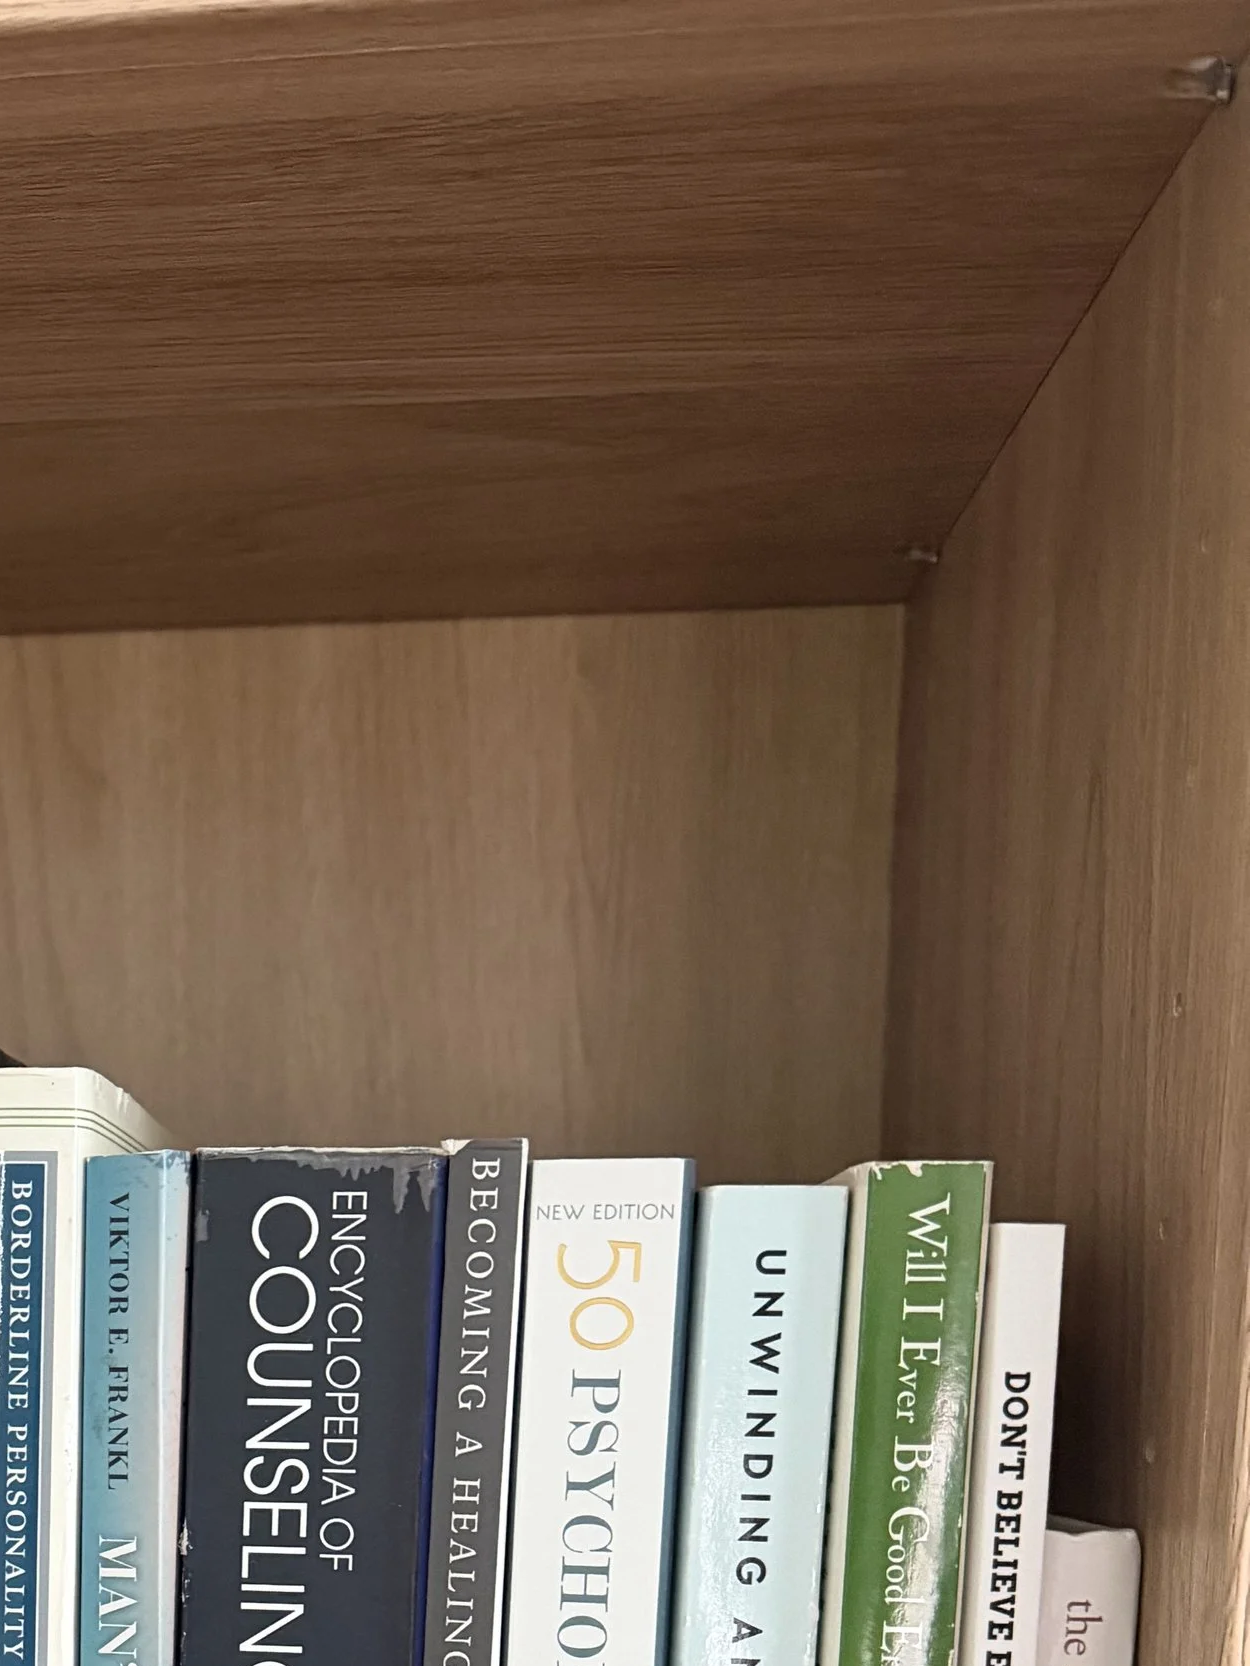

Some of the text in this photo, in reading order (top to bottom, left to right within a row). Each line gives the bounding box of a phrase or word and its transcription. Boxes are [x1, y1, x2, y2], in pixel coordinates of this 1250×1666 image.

[536, 1203, 675, 1221] NEW EDITION
[903, 1192, 950, 1286] Will
[7, 1180, 34, 1410] BORDERLINE
[458, 1157, 500, 1412] BECOMING
[557, 1239, 642, 1350] 50
[901, 1303, 943, 1322] I
[107, 1191, 130, 1490] VIKTOR FRANKL
[319, 1190, 368, 1571] ENCYCLOPEDIA OF
[896, 1336, 942, 1425] Ever
[454, 1431, 483, 1457] A
[735, 1249, 787, 1586] UNWINDING
[891, 1435, 934, 1492] Be
[997, 1371, 1031, 1481] DON'T
[2, 1423, 29, 1660] PERSONALITY
[883, 1506, 930, 1606] Good
[987, 1490, 1023, 1641] BELIEVE
[1064, 1600, 1103, 1657] the
